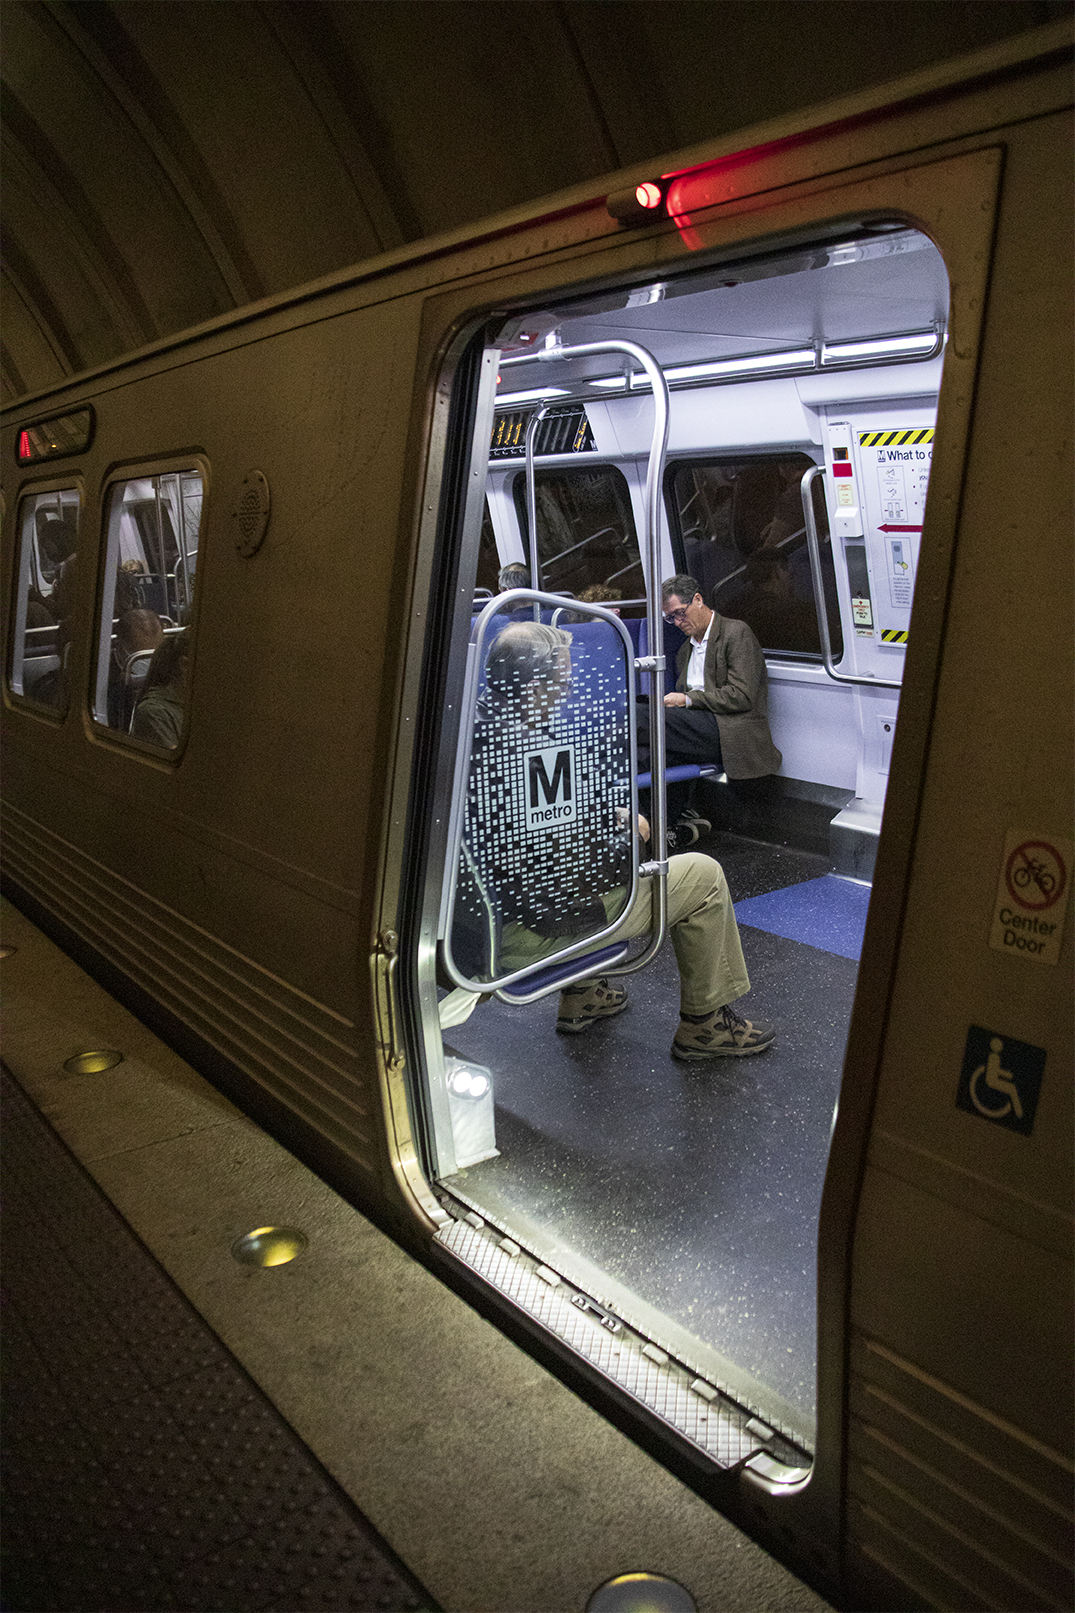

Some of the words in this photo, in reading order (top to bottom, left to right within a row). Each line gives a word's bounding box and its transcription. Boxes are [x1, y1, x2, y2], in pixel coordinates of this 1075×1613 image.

[887, 450, 913, 461] What
[915, 450, 926, 460] to
[528, 750, 572, 808] M
[531, 805, 572, 824] metro
[1000, 908, 1056, 935] Center
[1004, 930, 1046, 954] Door
